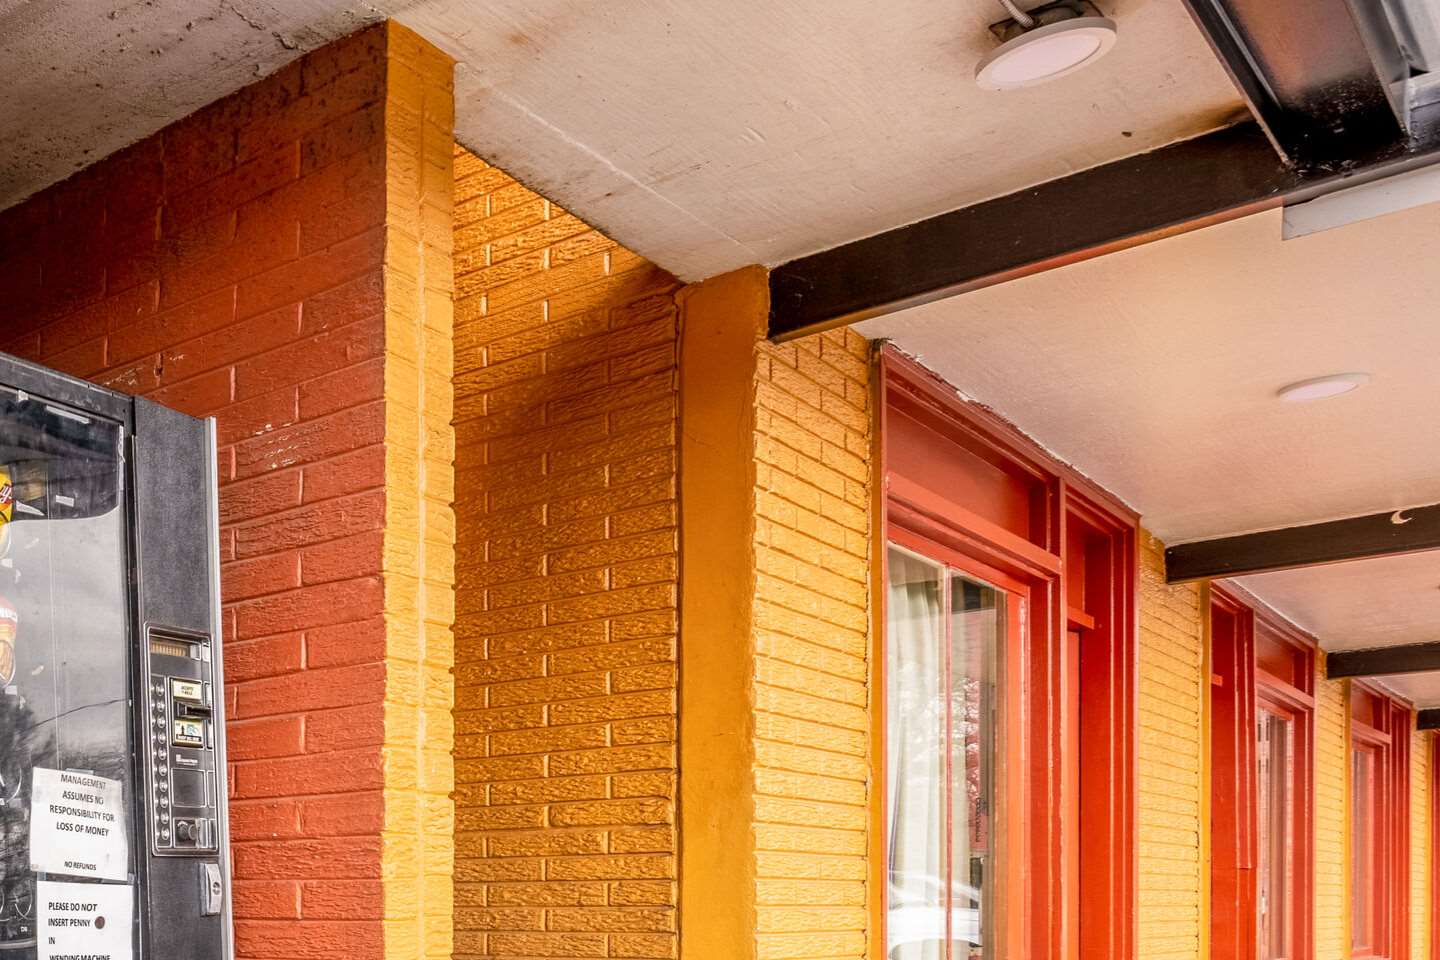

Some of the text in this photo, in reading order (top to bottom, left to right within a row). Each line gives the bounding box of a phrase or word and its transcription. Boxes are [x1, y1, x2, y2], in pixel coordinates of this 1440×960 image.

[61, 774, 106, 790] MANAGEMENT
[62, 790, 104, 805] ASSUMES NO
[49, 804, 115, 822] RESPONSIBILITY FOR
[56, 821, 110, 837] LOSS OF MONEY
[73, 861, 97, 871] REFUNDS
[48, 902, 98, 912] PLEASE DO NOT
[48, 918, 91, 927] INSERT PENNY
[48, 937, 56, 945] IN
